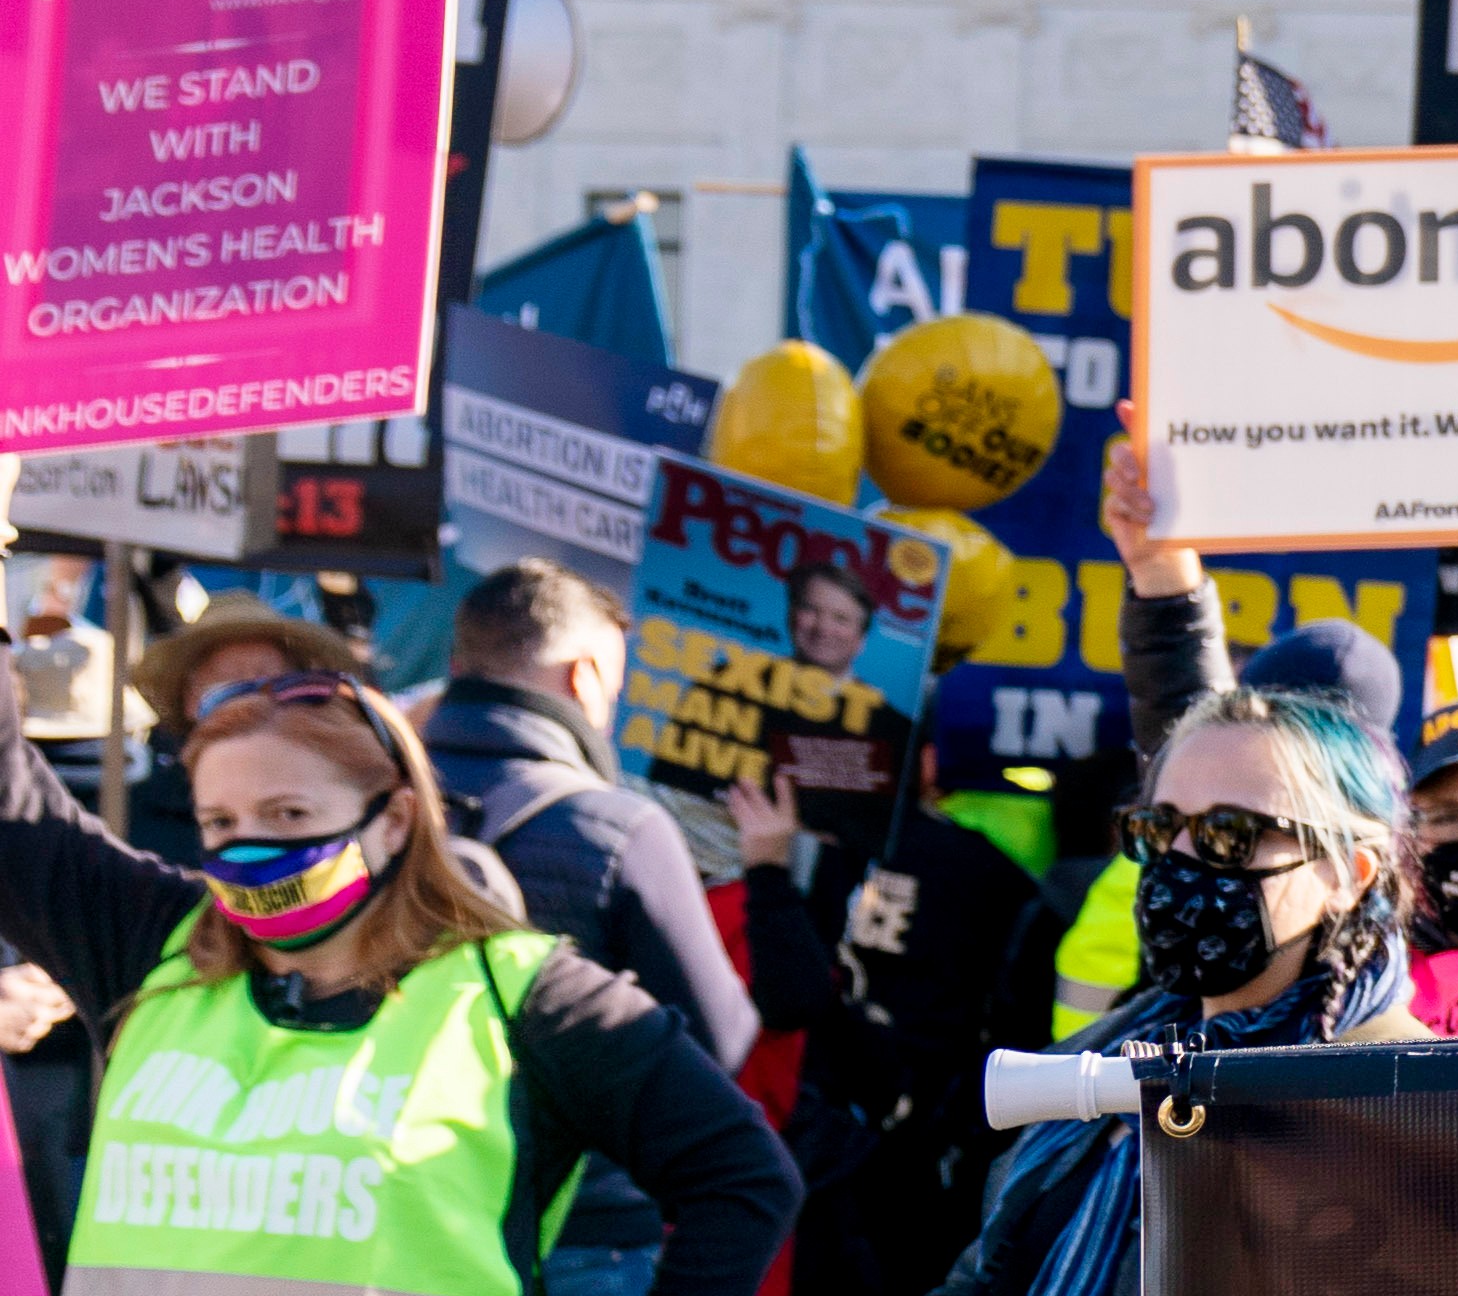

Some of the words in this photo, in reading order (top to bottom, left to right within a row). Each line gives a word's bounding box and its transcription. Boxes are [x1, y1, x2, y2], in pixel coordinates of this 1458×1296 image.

[99, 74, 170, 115] WE
[178, 59, 321, 107] STAND
[149, 119, 261, 163] WITH
[99, 169, 298, 222] JACKSON
[3, 232, 212, 286] WOMEN'S
[220, 212, 386, 265] HEALTH
[27, 271, 350, 338] ORGANIZATION
[460, 405, 606, 478] ABORTION
[613, 454, 643, 492] IS
[1168, 421, 1237, 446] How
[1246, 424, 1301, 450] you
[1314, 417, 1391, 442] want
[1400, 414, 1430, 439] it.
[574, 503, 634, 544] CAR
[626, 669, 762, 744] MAN
[636, 616, 887, 736] SEXIST
[990, 686, 1100, 759] IN
[94, 1140, 382, 1243] DEFENDERS
